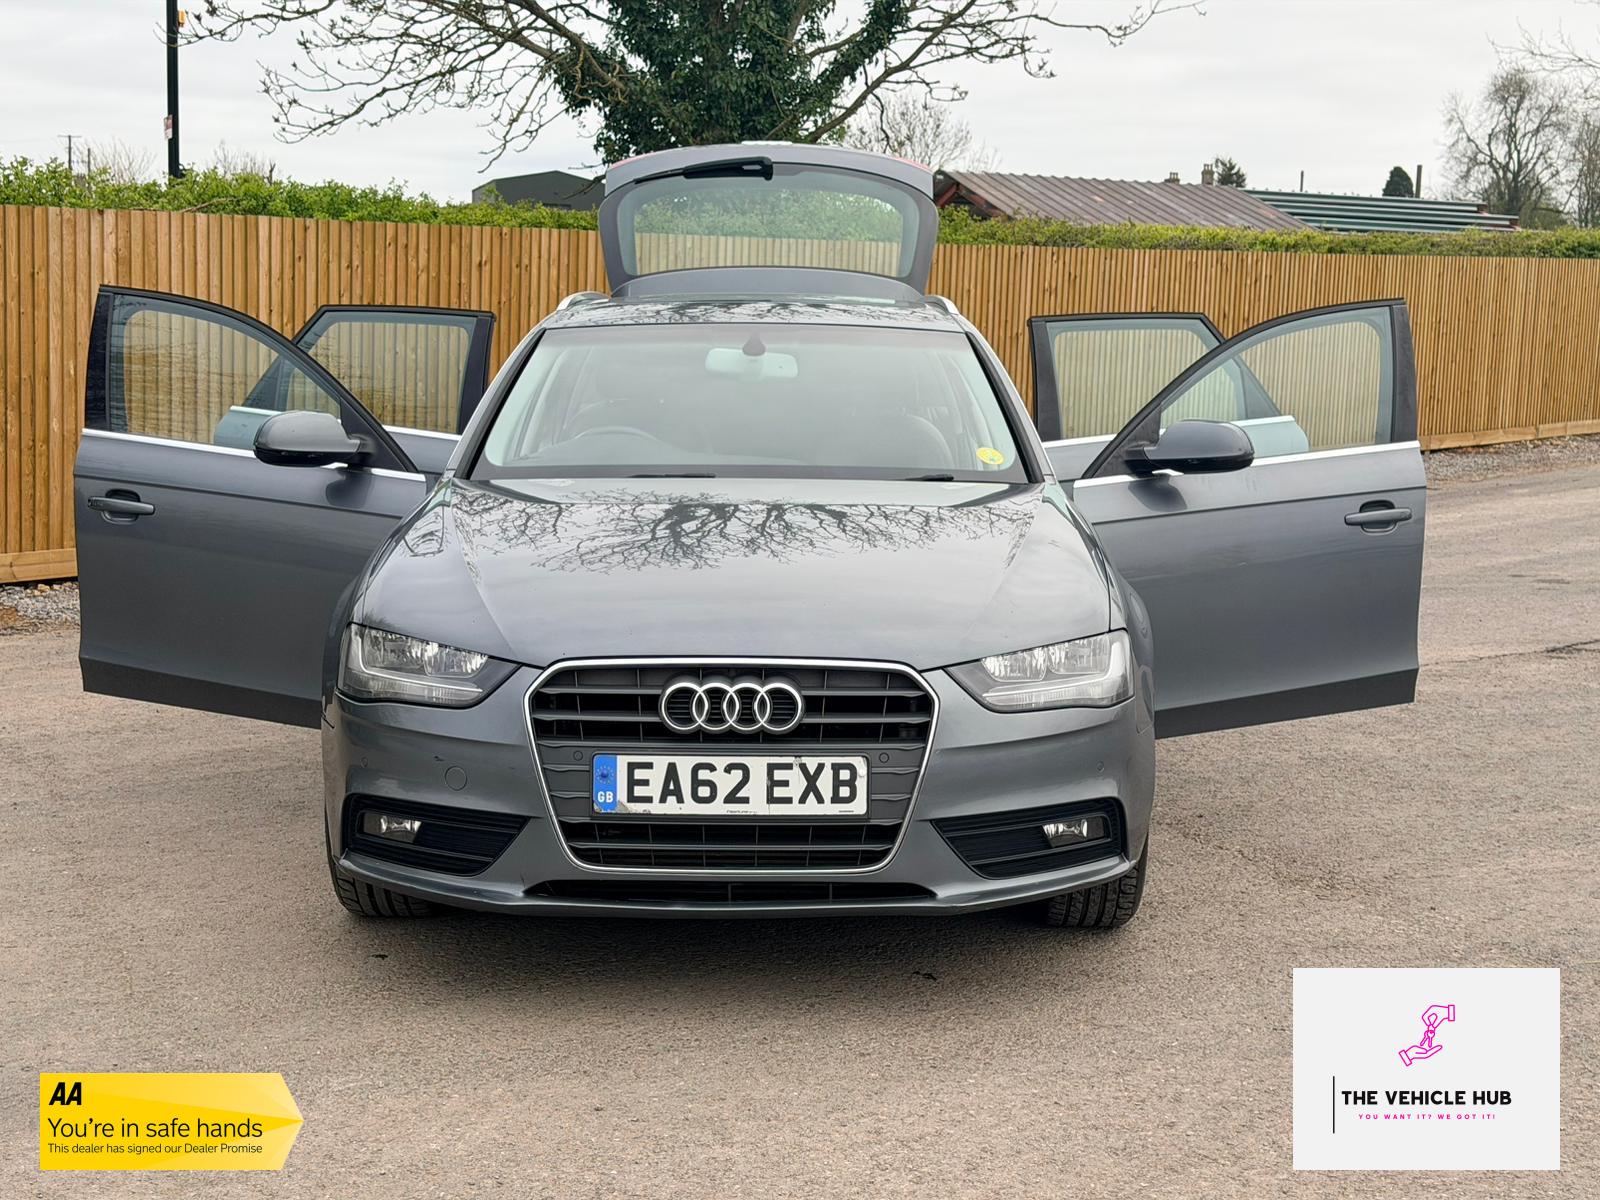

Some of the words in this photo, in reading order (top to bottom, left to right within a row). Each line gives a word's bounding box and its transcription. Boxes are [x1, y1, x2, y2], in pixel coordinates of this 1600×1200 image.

[597, 791, 614, 803] GB
[626, 761, 751, 804] EA62
[766, 761, 858, 805] EXB
